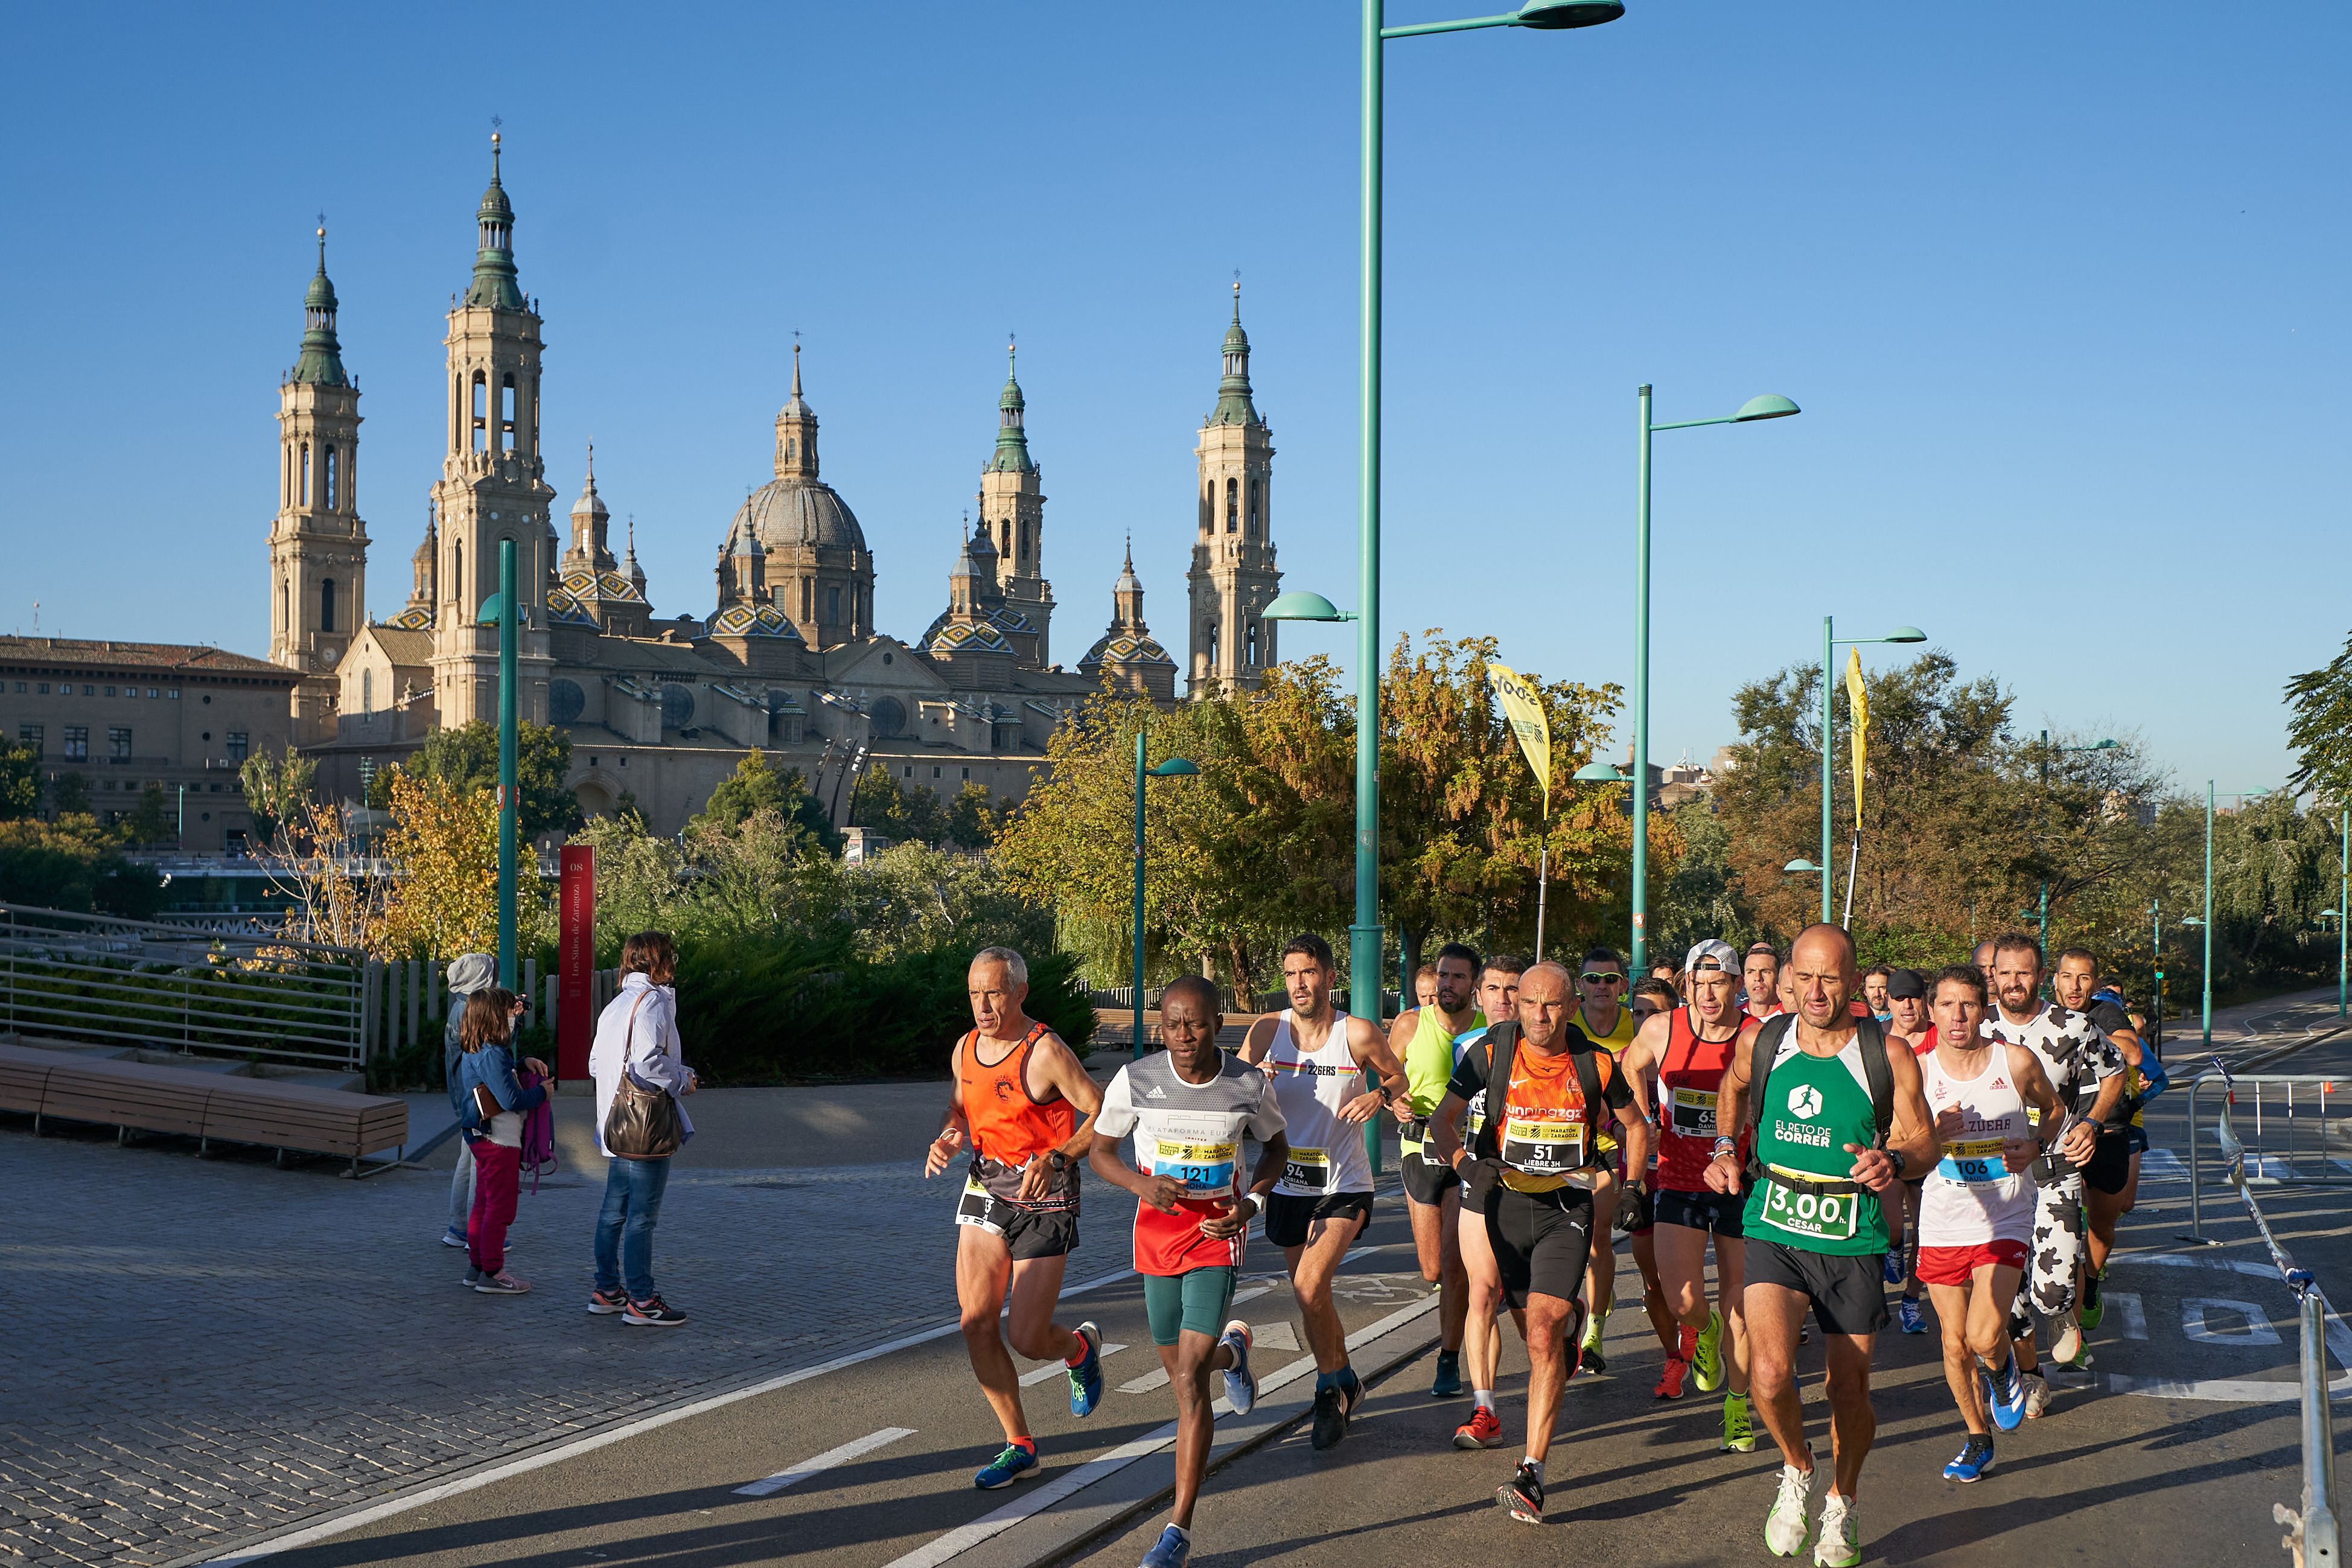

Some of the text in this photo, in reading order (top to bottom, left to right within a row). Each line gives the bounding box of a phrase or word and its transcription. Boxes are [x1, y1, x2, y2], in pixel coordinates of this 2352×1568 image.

[570, 863, 583, 872] 08
[572, 884, 581, 922] Zaragoza
[572, 923, 579, 935] de
[1308, 1065, 1336, 1076] 226ERS
[1148, 1126, 1206, 1135] PLATAFORMA
[1776, 1120, 1831, 1137] EL RETO DE
[1775, 1129, 1830, 1147] CORRER
[1534, 1145, 1553, 1160] 51
[1181, 1167, 1209, 1182] 121
[1287, 1164, 1304, 1178] 94
[1956, 1161, 1988, 1174] 106
[1284, 1176, 1308, 1185] ADRIANA
[1770, 1184, 1840, 1223] 3.00
[1787, 1217, 1822, 1232] CESAR
